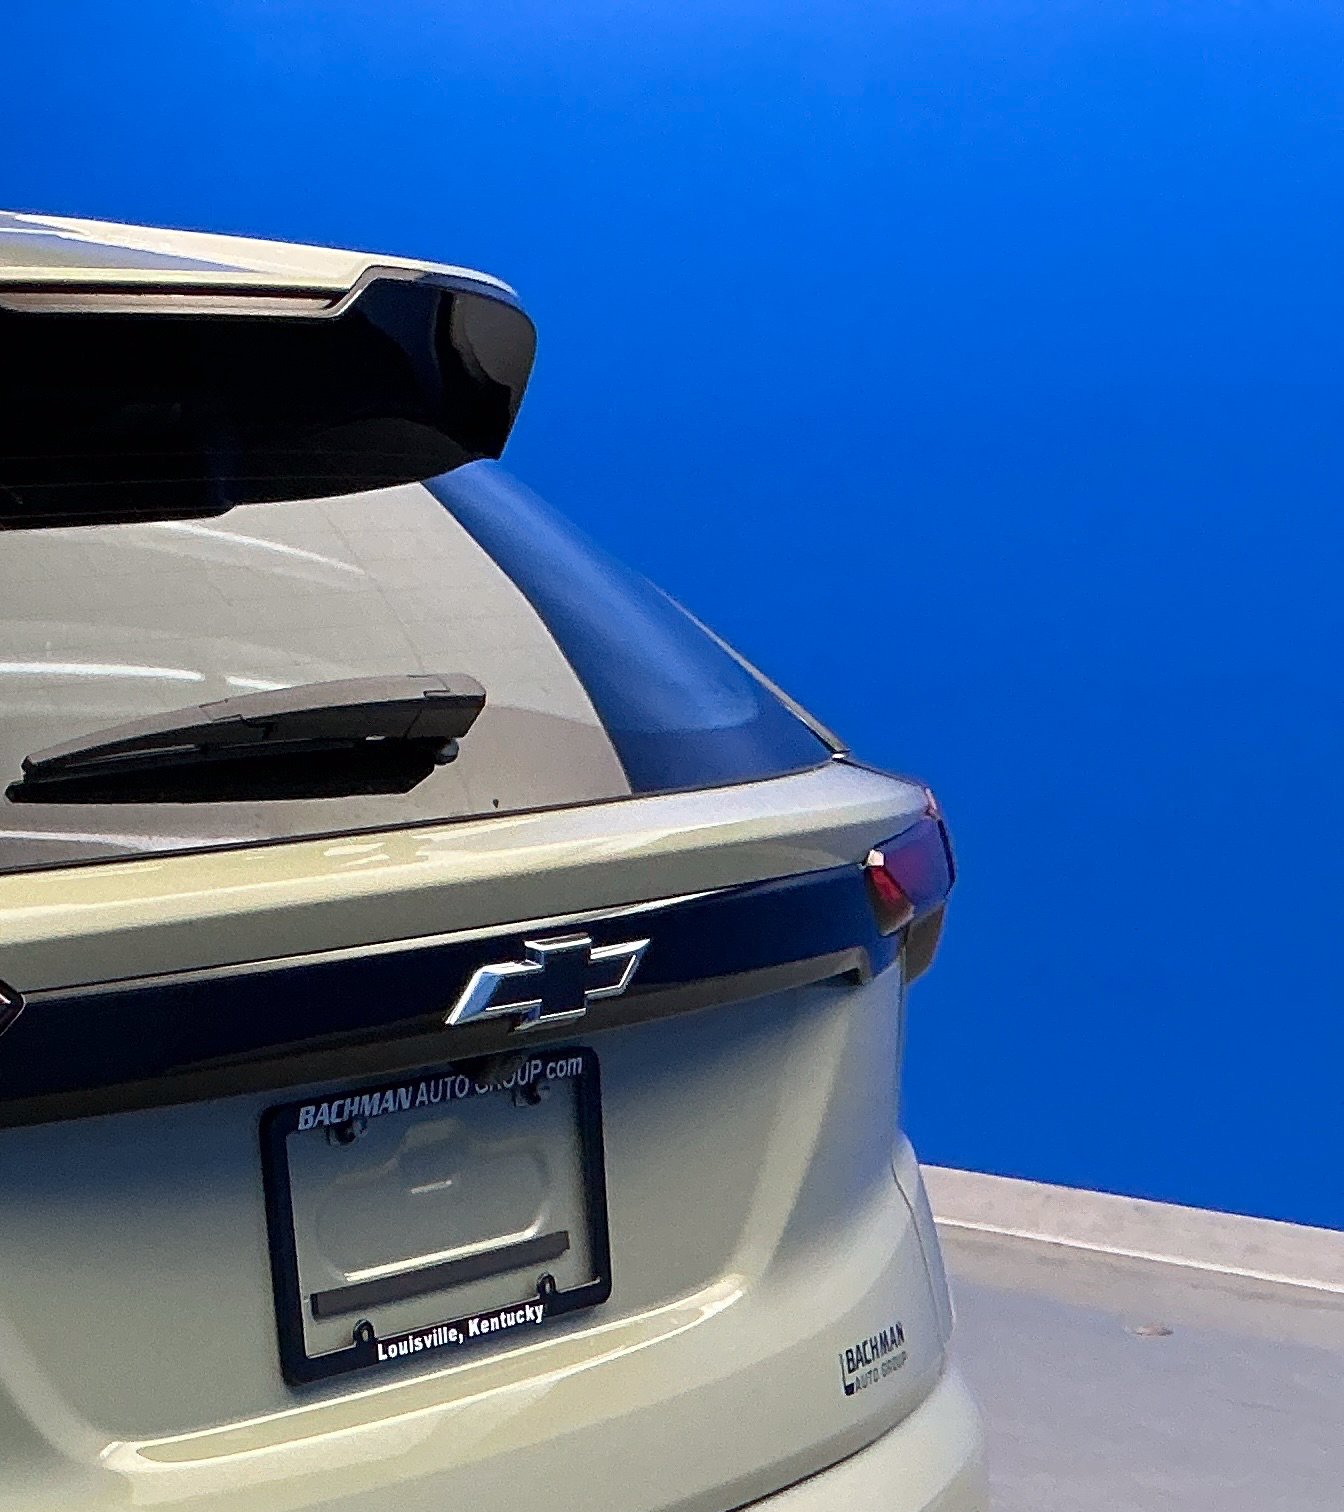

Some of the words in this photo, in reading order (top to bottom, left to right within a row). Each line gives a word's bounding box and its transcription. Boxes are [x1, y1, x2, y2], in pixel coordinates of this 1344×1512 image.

[298, 1086, 412, 1131] BACHMAN
[415, 1074, 469, 1107] AUTO
[377, 1325, 464, 1361] Louisville,
[468, 1303, 544, 1337] Kentucky
[845, 1321, 905, 1374] BACHMAN
